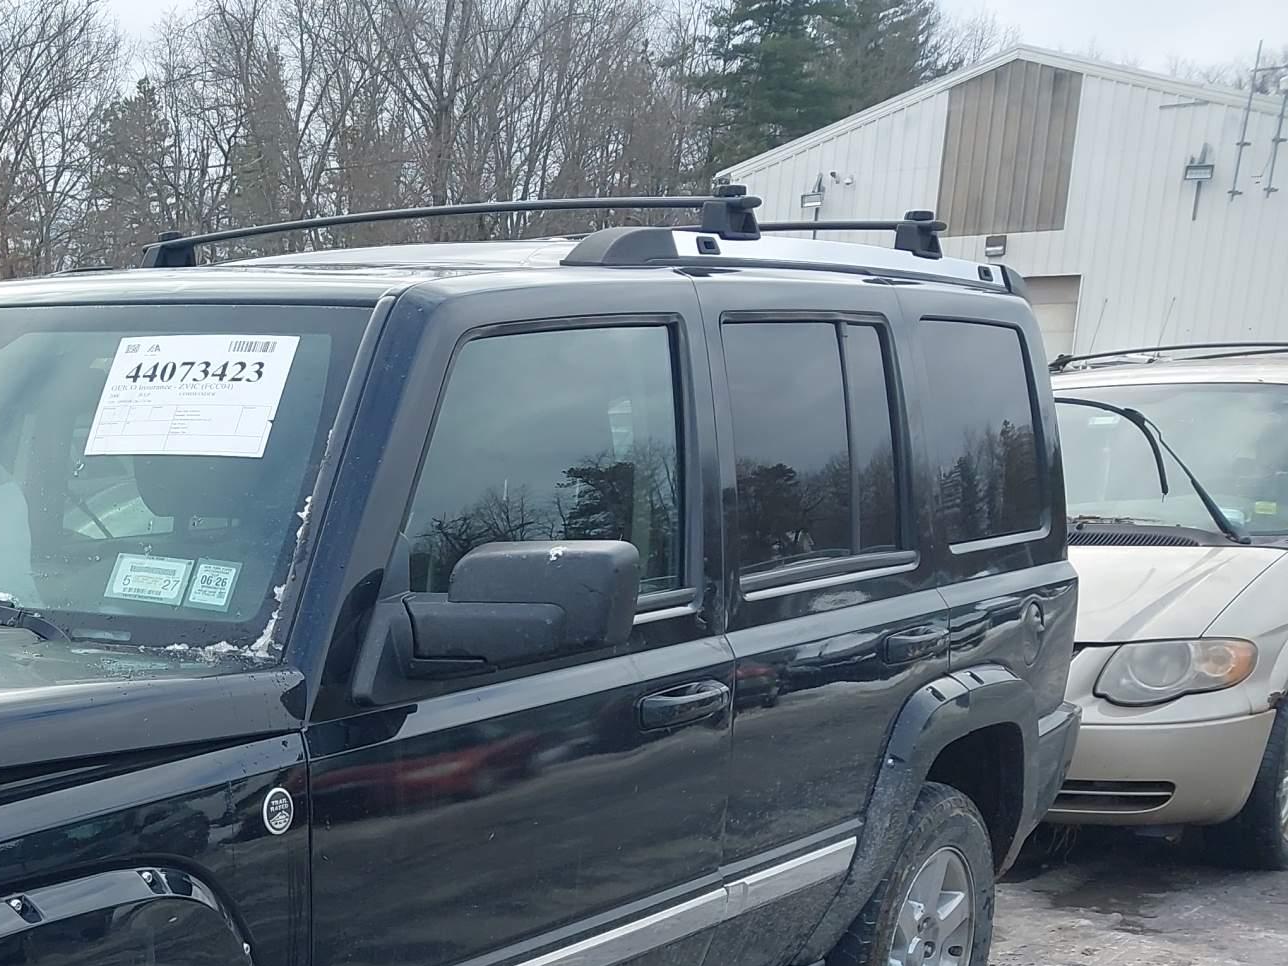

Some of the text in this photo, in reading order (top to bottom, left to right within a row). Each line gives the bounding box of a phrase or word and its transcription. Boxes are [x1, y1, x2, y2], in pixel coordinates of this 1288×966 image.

[125, 361, 265, 383] 44073423
[122, 574, 181, 591] 5 27
[200, 574, 229, 587] 06 26
